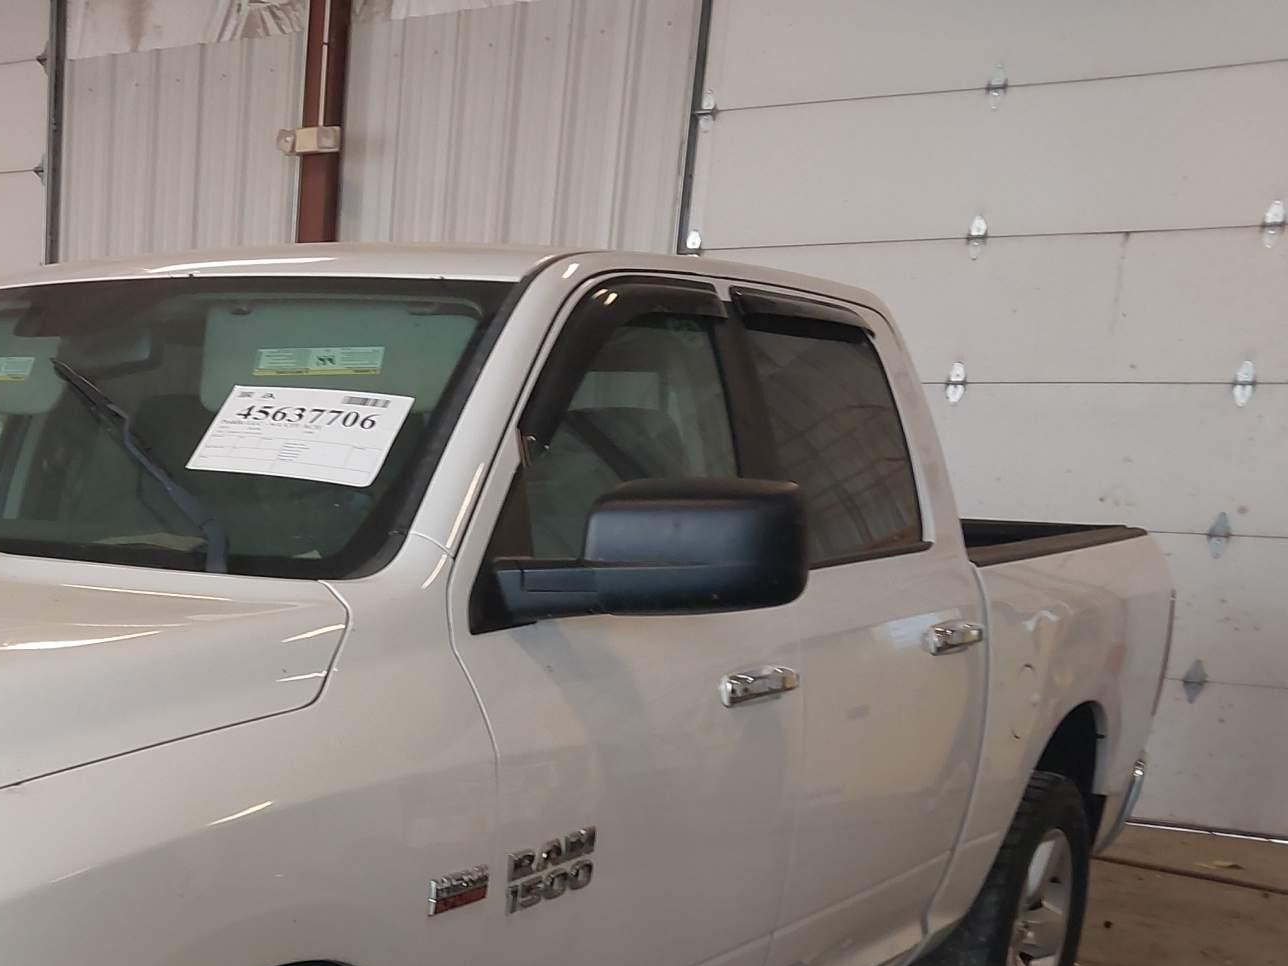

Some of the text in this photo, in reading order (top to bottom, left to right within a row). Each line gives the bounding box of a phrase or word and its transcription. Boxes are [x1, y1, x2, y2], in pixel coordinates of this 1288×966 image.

[237, 405, 381, 430] 45637706
[508, 827, 596, 881] RAM
[507, 860, 593, 914] 1500
